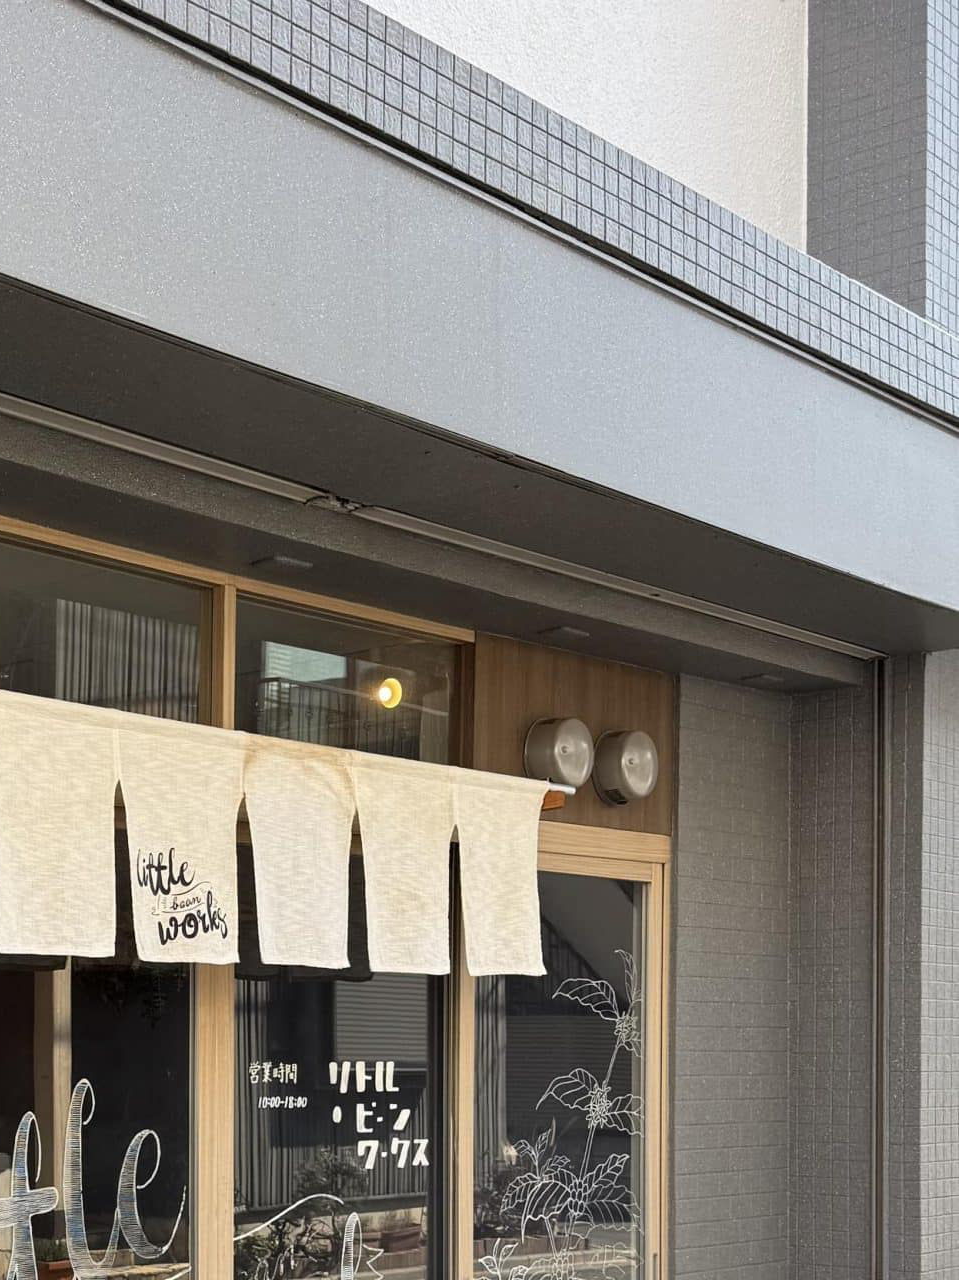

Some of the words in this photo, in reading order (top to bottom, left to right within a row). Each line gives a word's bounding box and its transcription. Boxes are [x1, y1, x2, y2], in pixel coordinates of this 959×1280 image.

[137, 847, 196, 896] little
[158, 890, 228, 945] works
[248, 1061, 298, 1085] 営業時間
[329, 1061, 399, 1093] リトル
[258, 1096, 308, 1109] 10:00-18:00
[356, 1102, 411, 1133] ビーン
[357, 1138, 430, 1170] ワークス
